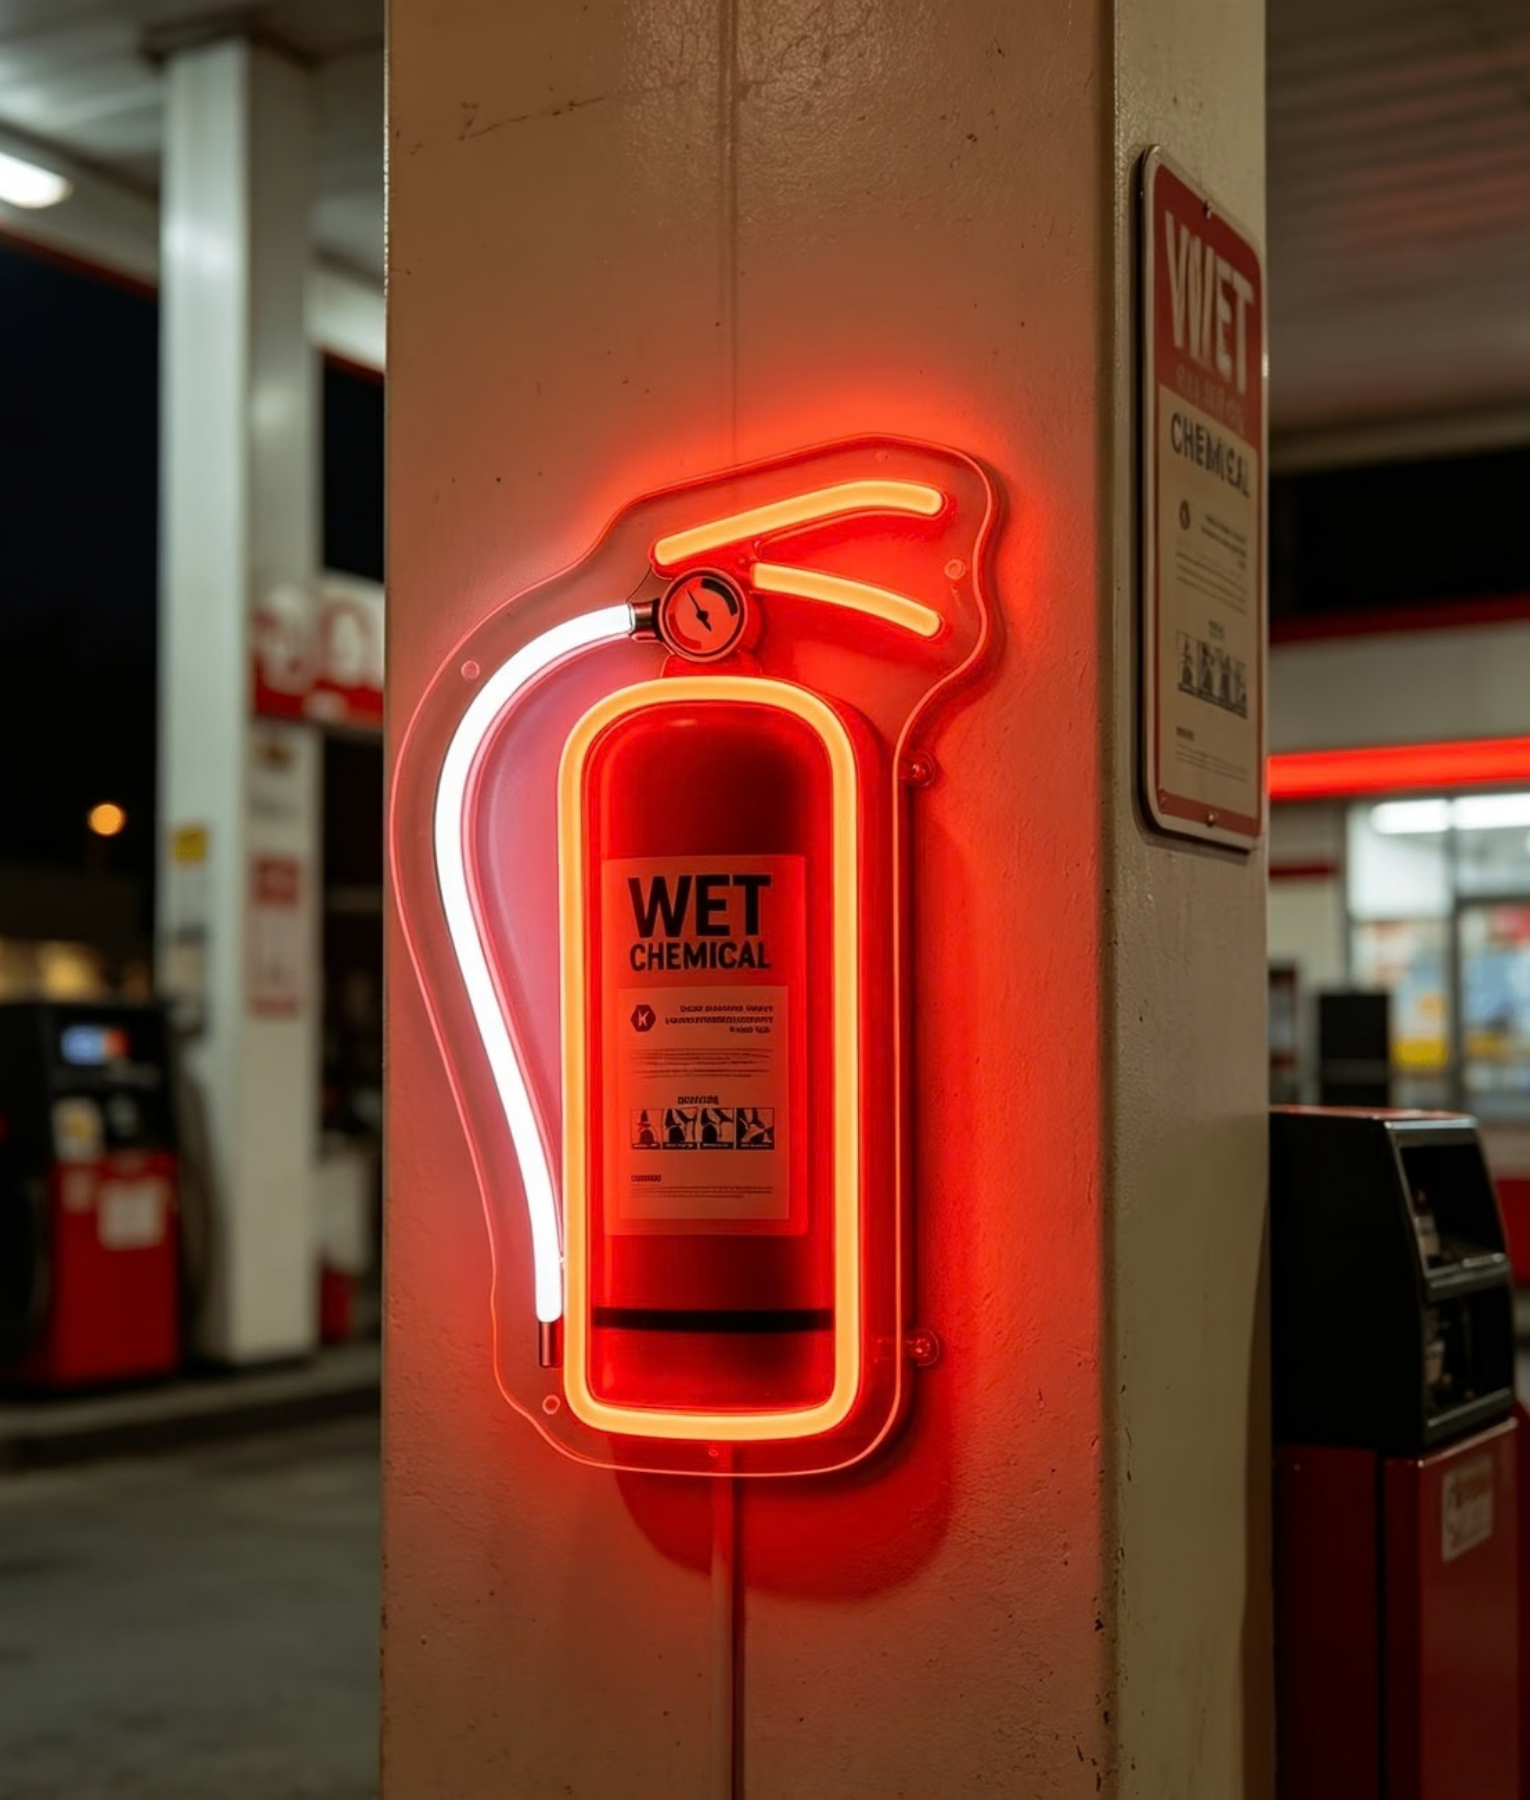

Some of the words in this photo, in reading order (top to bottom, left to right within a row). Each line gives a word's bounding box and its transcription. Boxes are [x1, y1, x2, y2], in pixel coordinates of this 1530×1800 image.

[627, 874, 771, 938] WET
[629, 941, 771, 971] CHEMICAL
[638, 1011, 650, 1028] K
